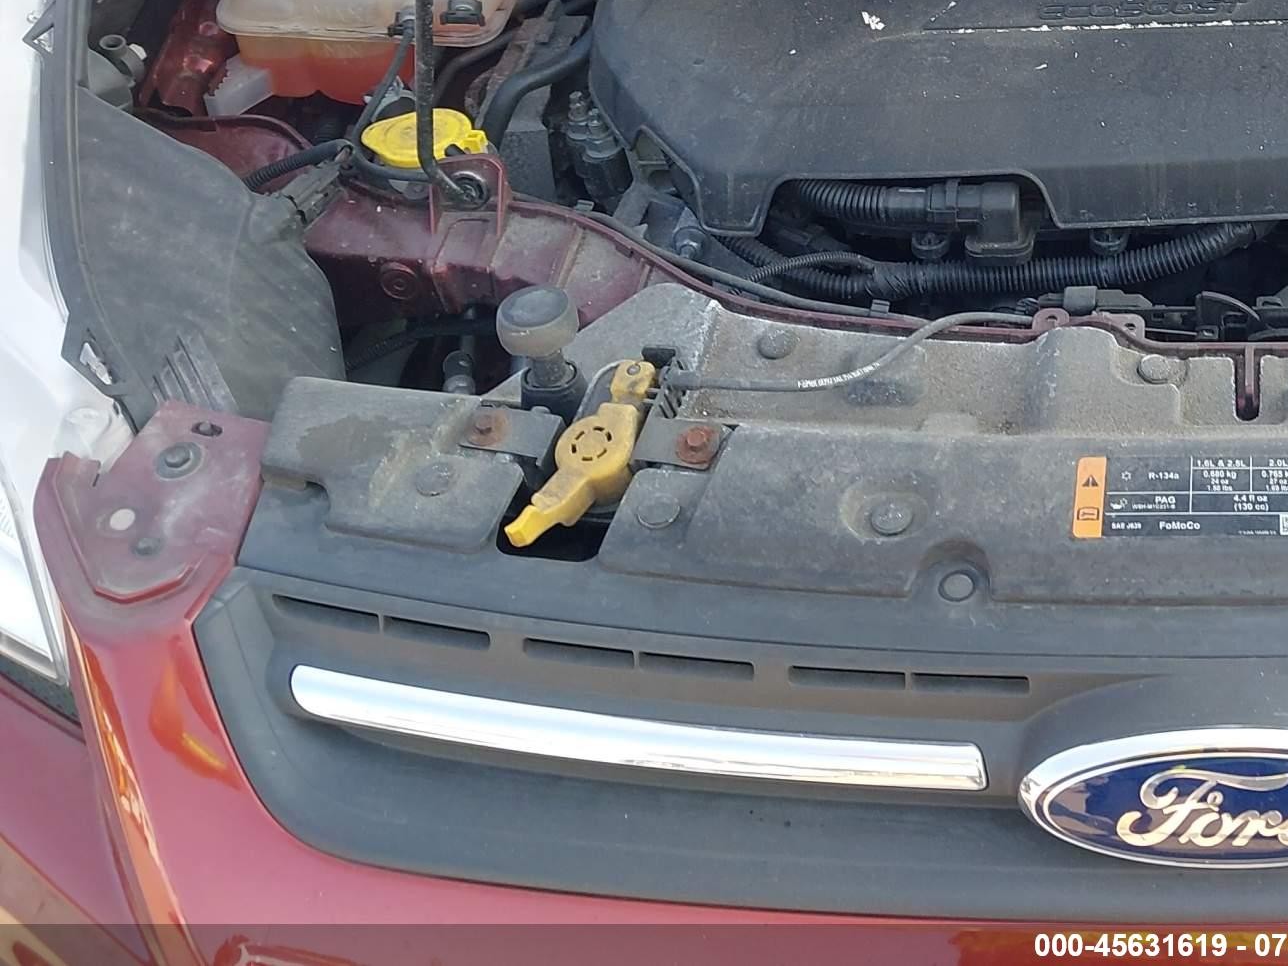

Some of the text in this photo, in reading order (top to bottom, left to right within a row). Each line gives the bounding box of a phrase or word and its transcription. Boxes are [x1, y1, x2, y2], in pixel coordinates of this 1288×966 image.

[1197, 459, 1215, 468] 1.6L
[1227, 459, 1247, 468] 2.5L
[1268, 458, 1288, 467] 2.0L
[1148, 471, 1180, 480] R-134a
[1226, 469, 1238, 480] kg
[1154, 495, 1177, 504] PAG
[1233, 494, 1247, 502] 4.4
[1159, 520, 1201, 530] FoMoCo
